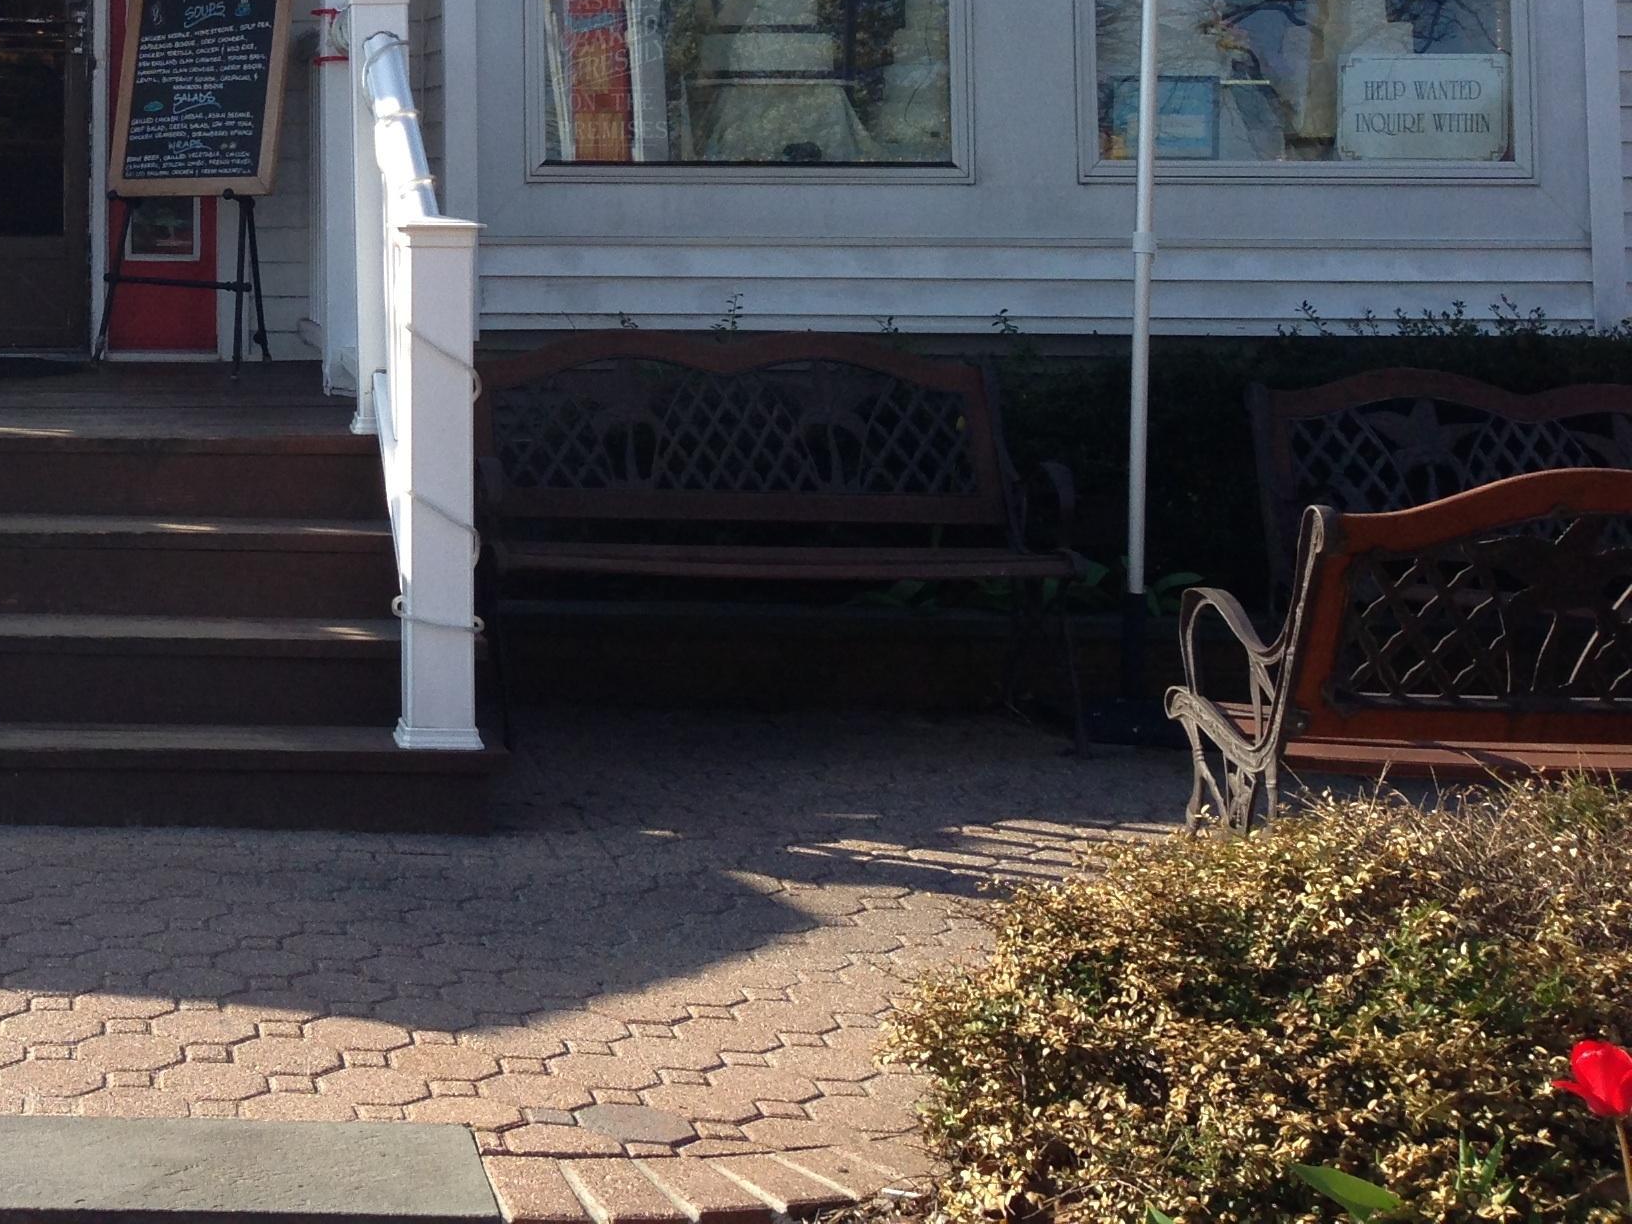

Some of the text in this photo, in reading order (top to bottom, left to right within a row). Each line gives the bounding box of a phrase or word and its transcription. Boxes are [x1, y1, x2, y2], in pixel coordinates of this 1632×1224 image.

[184, 1, 226, 21] SOUPS
[565, 38, 665, 84] FRESLY
[173, 91, 216, 105] SALADS
[1363, 79, 1482, 101] HELP WANTED
[569, 92, 596, 112] ON
[1355, 112, 1491, 136] INQUIRE WITHIN
[168, 138, 203, 150] WRAPS
